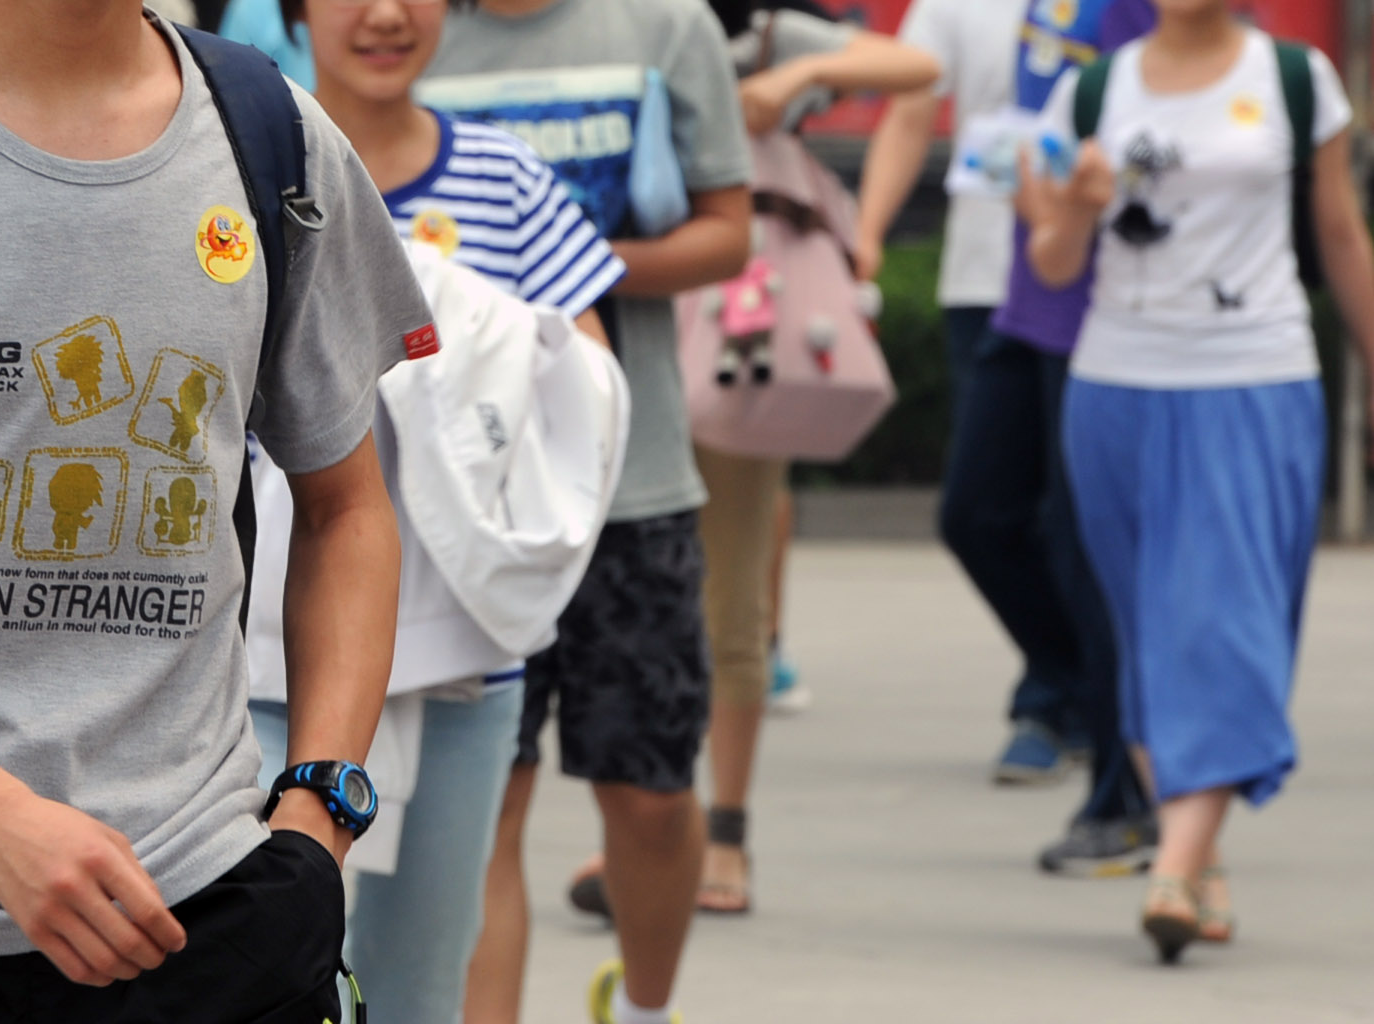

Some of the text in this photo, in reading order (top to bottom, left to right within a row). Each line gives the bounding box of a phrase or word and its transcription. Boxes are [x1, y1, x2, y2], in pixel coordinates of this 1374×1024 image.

[57, 569, 80, 580] that
[82, 569, 109, 581] does
[112, 570, 131, 581] not
[23, 582, 206, 626] STRANGER
[100, 621, 131, 635] food
[135, 624, 155, 637] for
